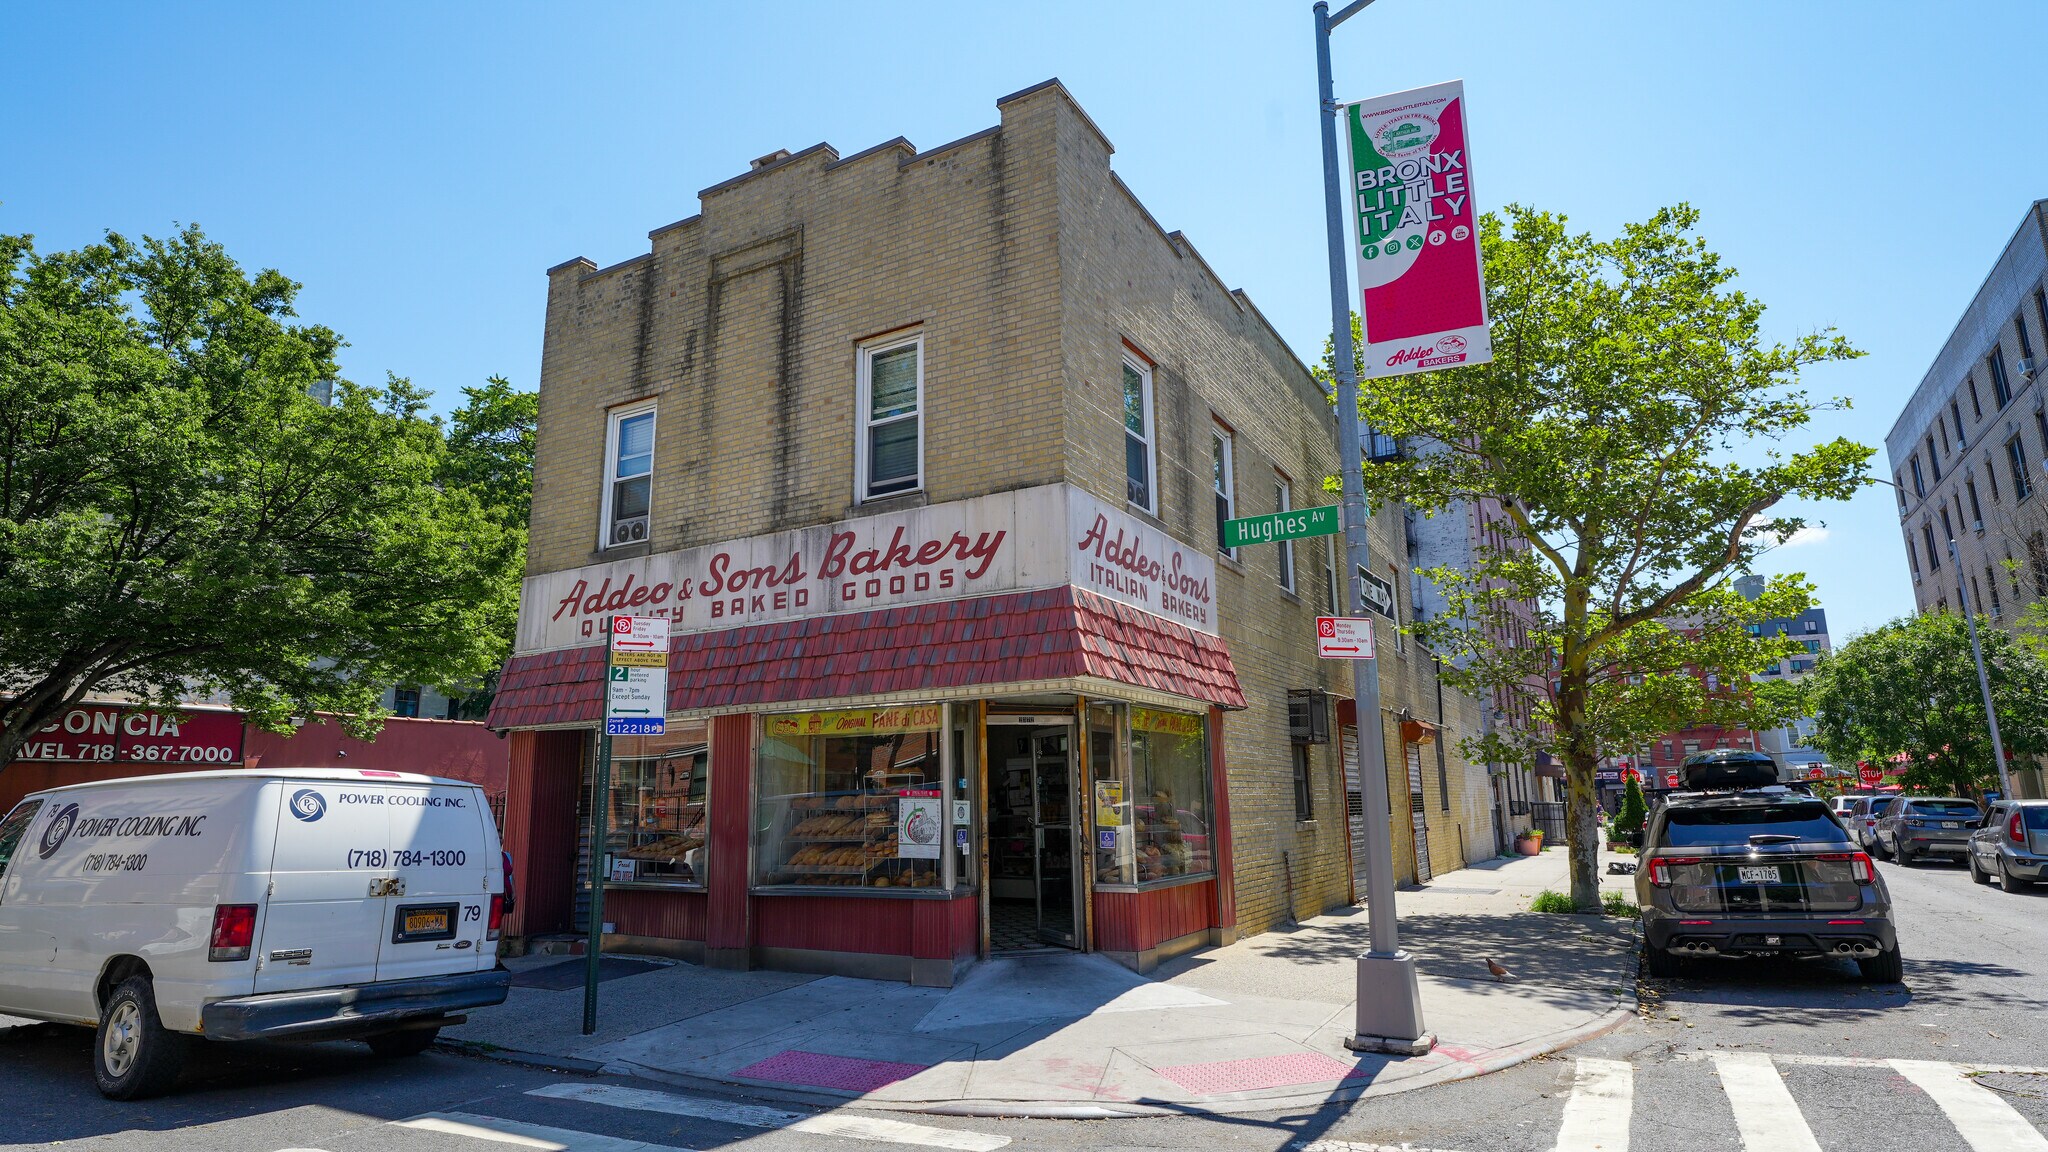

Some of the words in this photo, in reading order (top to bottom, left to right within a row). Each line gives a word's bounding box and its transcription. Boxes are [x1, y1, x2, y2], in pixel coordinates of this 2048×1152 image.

[1361, 98, 1447, 119] WWW.BRONXLITTLEITALY.COM
[1388, 115, 1403, 125] ITALY
[1422, 114, 1437, 126] BRONX
[1357, 149, 1464, 191] BRONX
[1358, 172, 1466, 214] LITTLE
[1361, 194, 1466, 237] ITALY
[1386, 346, 1434, 367] Addeo
[1423, 355, 1460, 367] BAKERS
[1238, 515, 1307, 542] Hughes
[1311, 510, 1326, 523] Av
[1078, 513, 1161, 582] Addeo
[1168, 551, 1211, 604] Sons
[552, 574, 674, 622] Addeo
[677, 578, 694, 601] &
[699, 551, 808, 597] Sons
[816, 526, 1007, 580] Bakery
[711, 588, 809, 618] BAKED
[841, 569, 954, 601] GOODS
[1090, 562, 1148, 602] ITALIAN
[1161, 592, 1207, 625] BAKERY
[1363, 580, 1374, 600] ONE
[1376, 588, 1389, 608] WAY
[1336, 622, 1352, 630] Monday
[614, 666, 625, 681] 2
[611, 693, 630, 701] Except
[631, 693, 651, 701] Sunday
[835, 716, 867, 731] ORIGINAL
[872, 711, 900, 729] PANE
[901, 713, 910, 727] di
[913, 707, 939, 726] CASA
[1861, 770, 1882, 778] STOP
[46, 803, 61, 818] 79
[338, 793, 384, 806] POWER
[388, 795, 442, 808] COOLING
[444, 797, 466, 809] INC.
[73, 817, 119, 838] POWER
[117, 816, 180, 837] COOLING
[174, 815, 207, 837] INC.
[82, 852, 106, 872] (718)
[103, 853, 148, 871] 784-1300
[347, 848, 388, 869] (718)
[392, 850, 466, 867] 784-1300
[463, 905, 481, 922] 79
